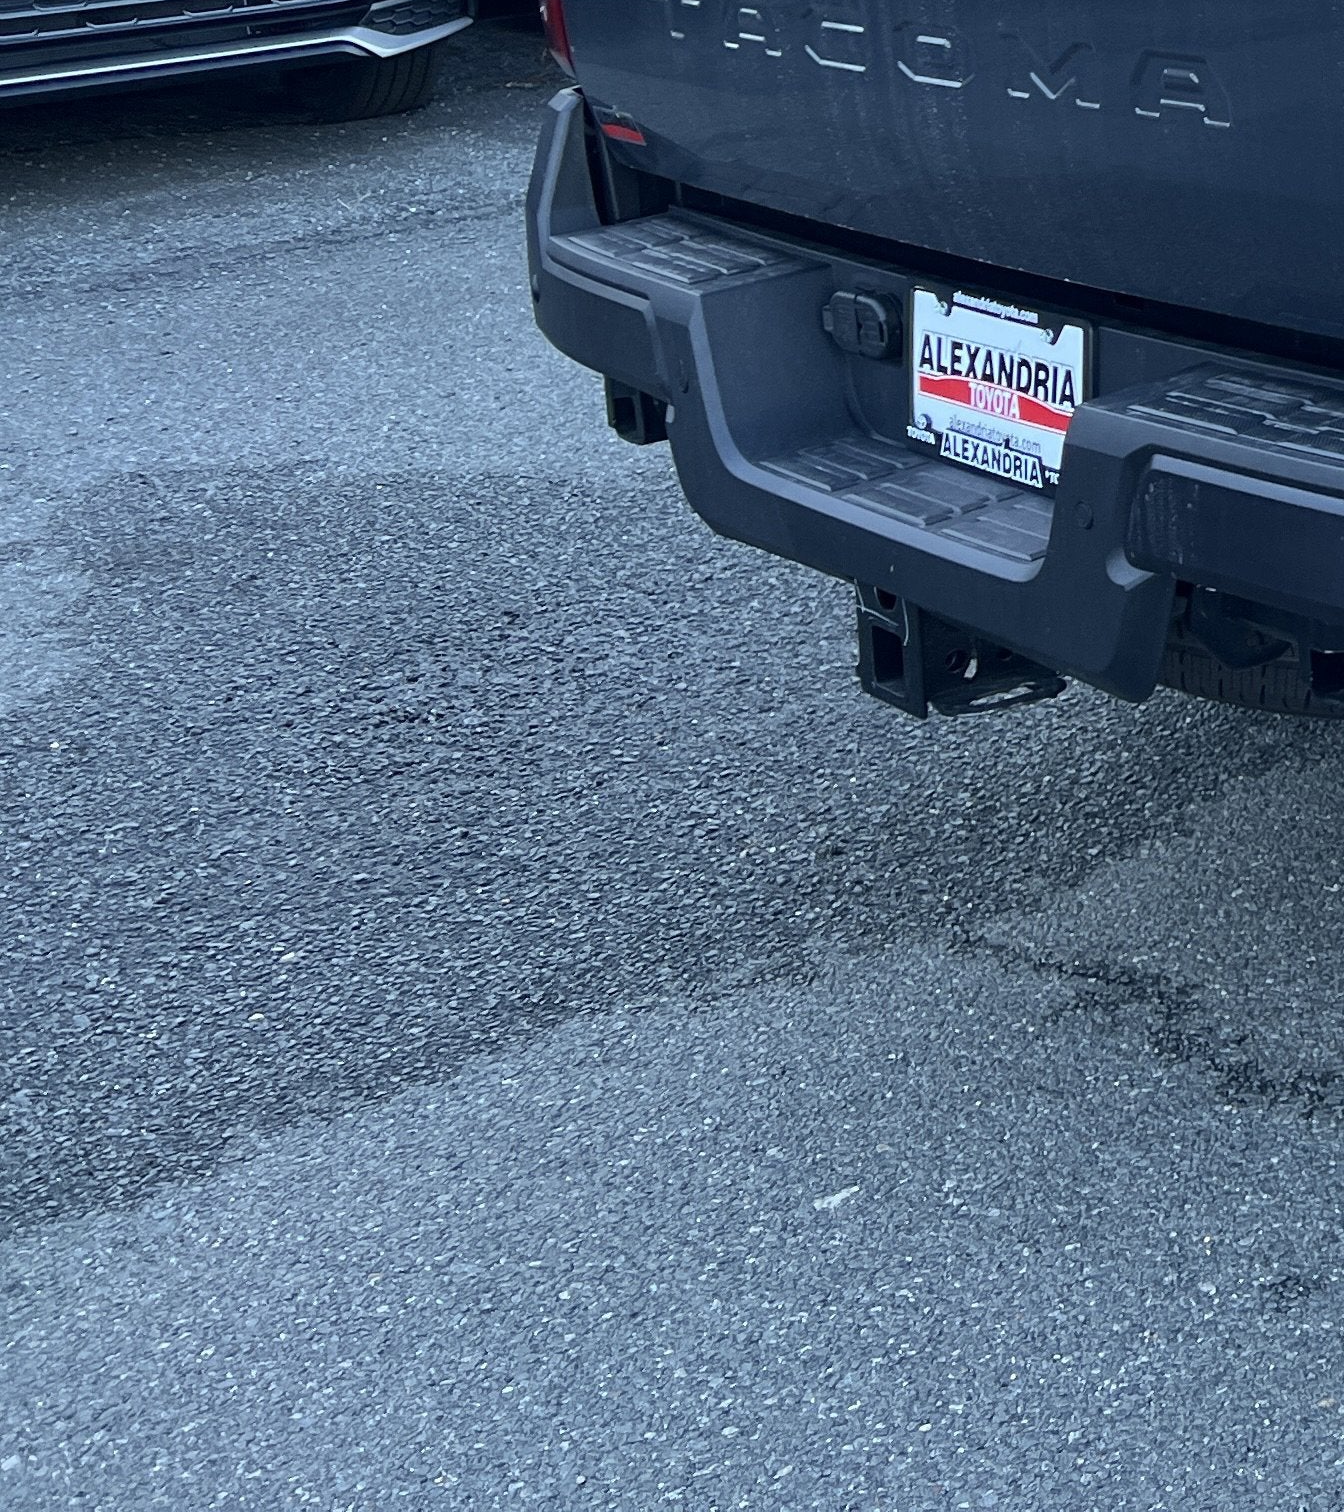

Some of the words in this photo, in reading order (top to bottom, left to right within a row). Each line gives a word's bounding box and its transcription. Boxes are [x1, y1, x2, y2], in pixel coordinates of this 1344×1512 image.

[918, 333, 1076, 408] ALEXANDRIA
[969, 382, 1021, 420] TOYOTA
[942, 431, 1042, 486] ALEXANDRIA
